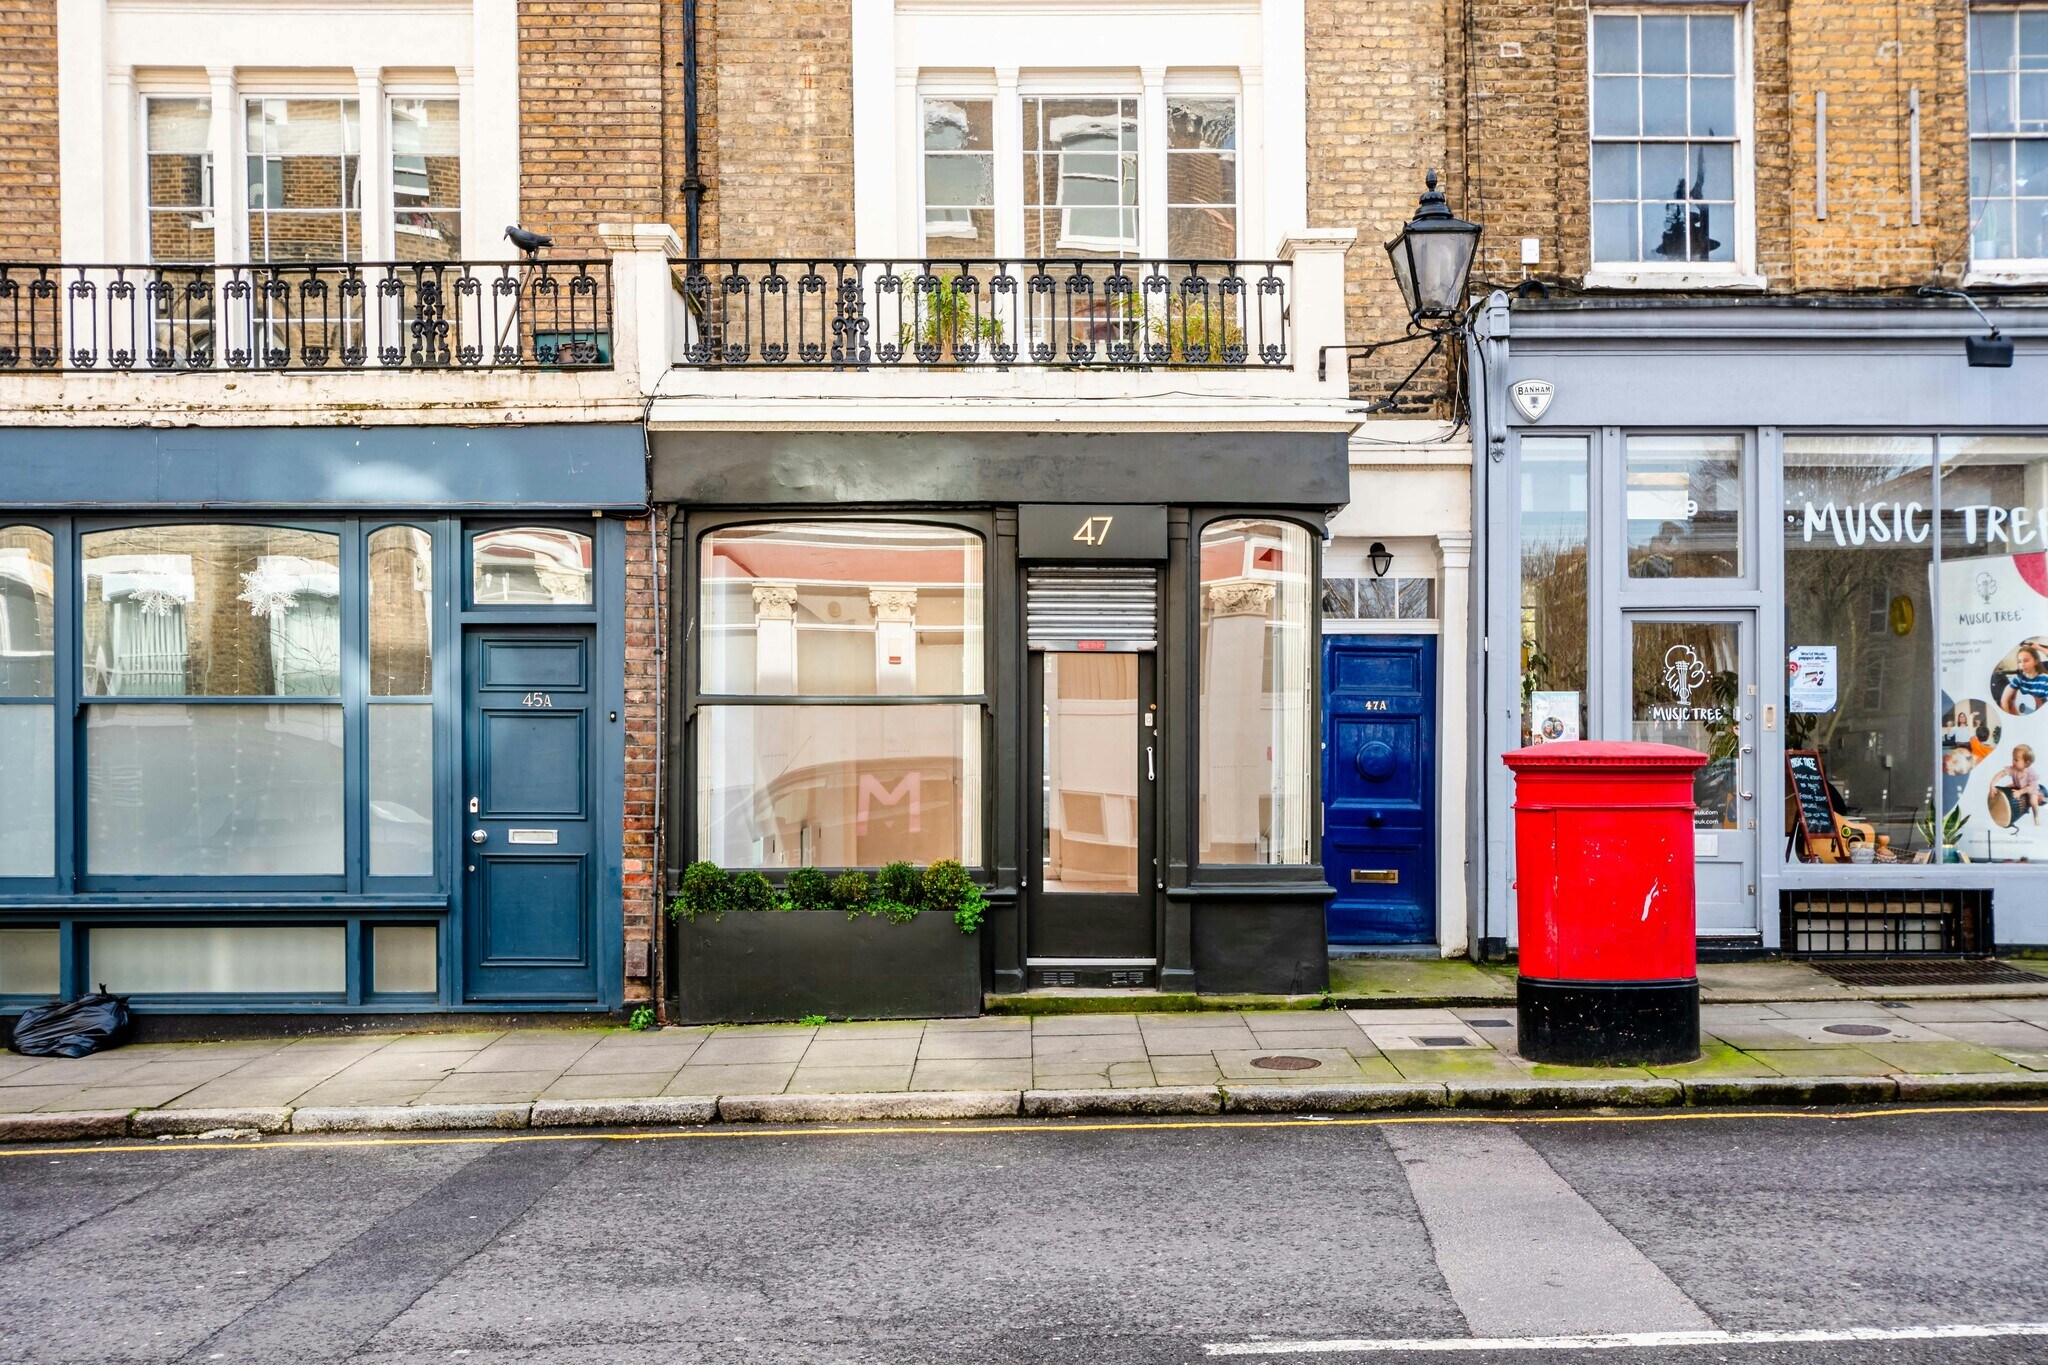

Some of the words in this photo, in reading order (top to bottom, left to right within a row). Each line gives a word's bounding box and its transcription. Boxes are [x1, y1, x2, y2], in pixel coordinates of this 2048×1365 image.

[1517, 386, 1551, 396] BANHAM
[1072, 516, 1114, 546] 47
[1803, 501, 1930, 547] MUSIC
[1959, 612, 1992, 626] MUSIC
[1993, 609, 2022, 623] TREE
[522, 692, 553, 708] 45A
[1365, 700, 1387, 711] 47A
[1653, 706, 1691, 721] MUSIC
[1691, 707, 1724, 721] TREE
[856, 772, 921, 837] M
